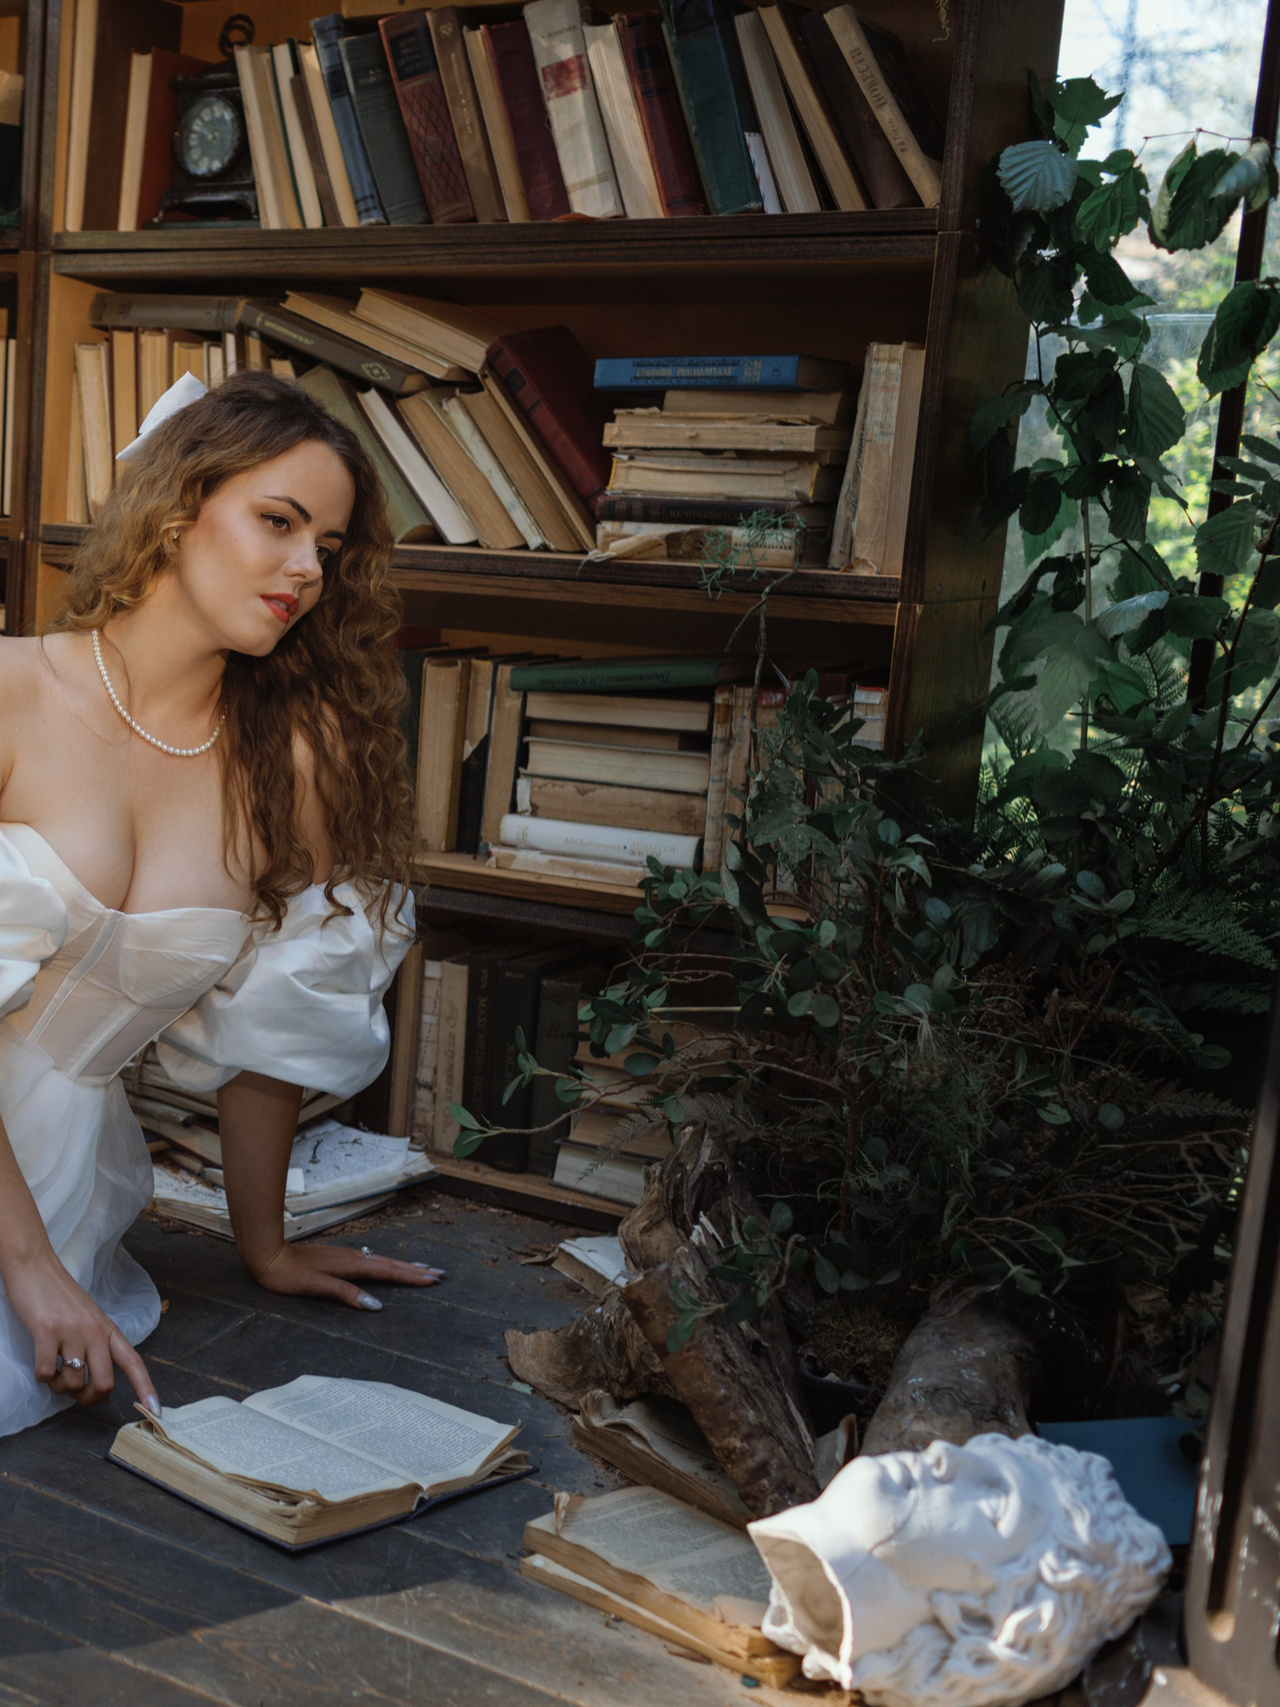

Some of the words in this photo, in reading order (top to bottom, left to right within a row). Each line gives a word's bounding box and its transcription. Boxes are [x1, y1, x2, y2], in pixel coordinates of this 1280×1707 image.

[849, 47, 888, 109] ПОВЕСТИ
[476, 995, 489, 1029] MASS
[474, 1032, 487, 1073] MEDIA
